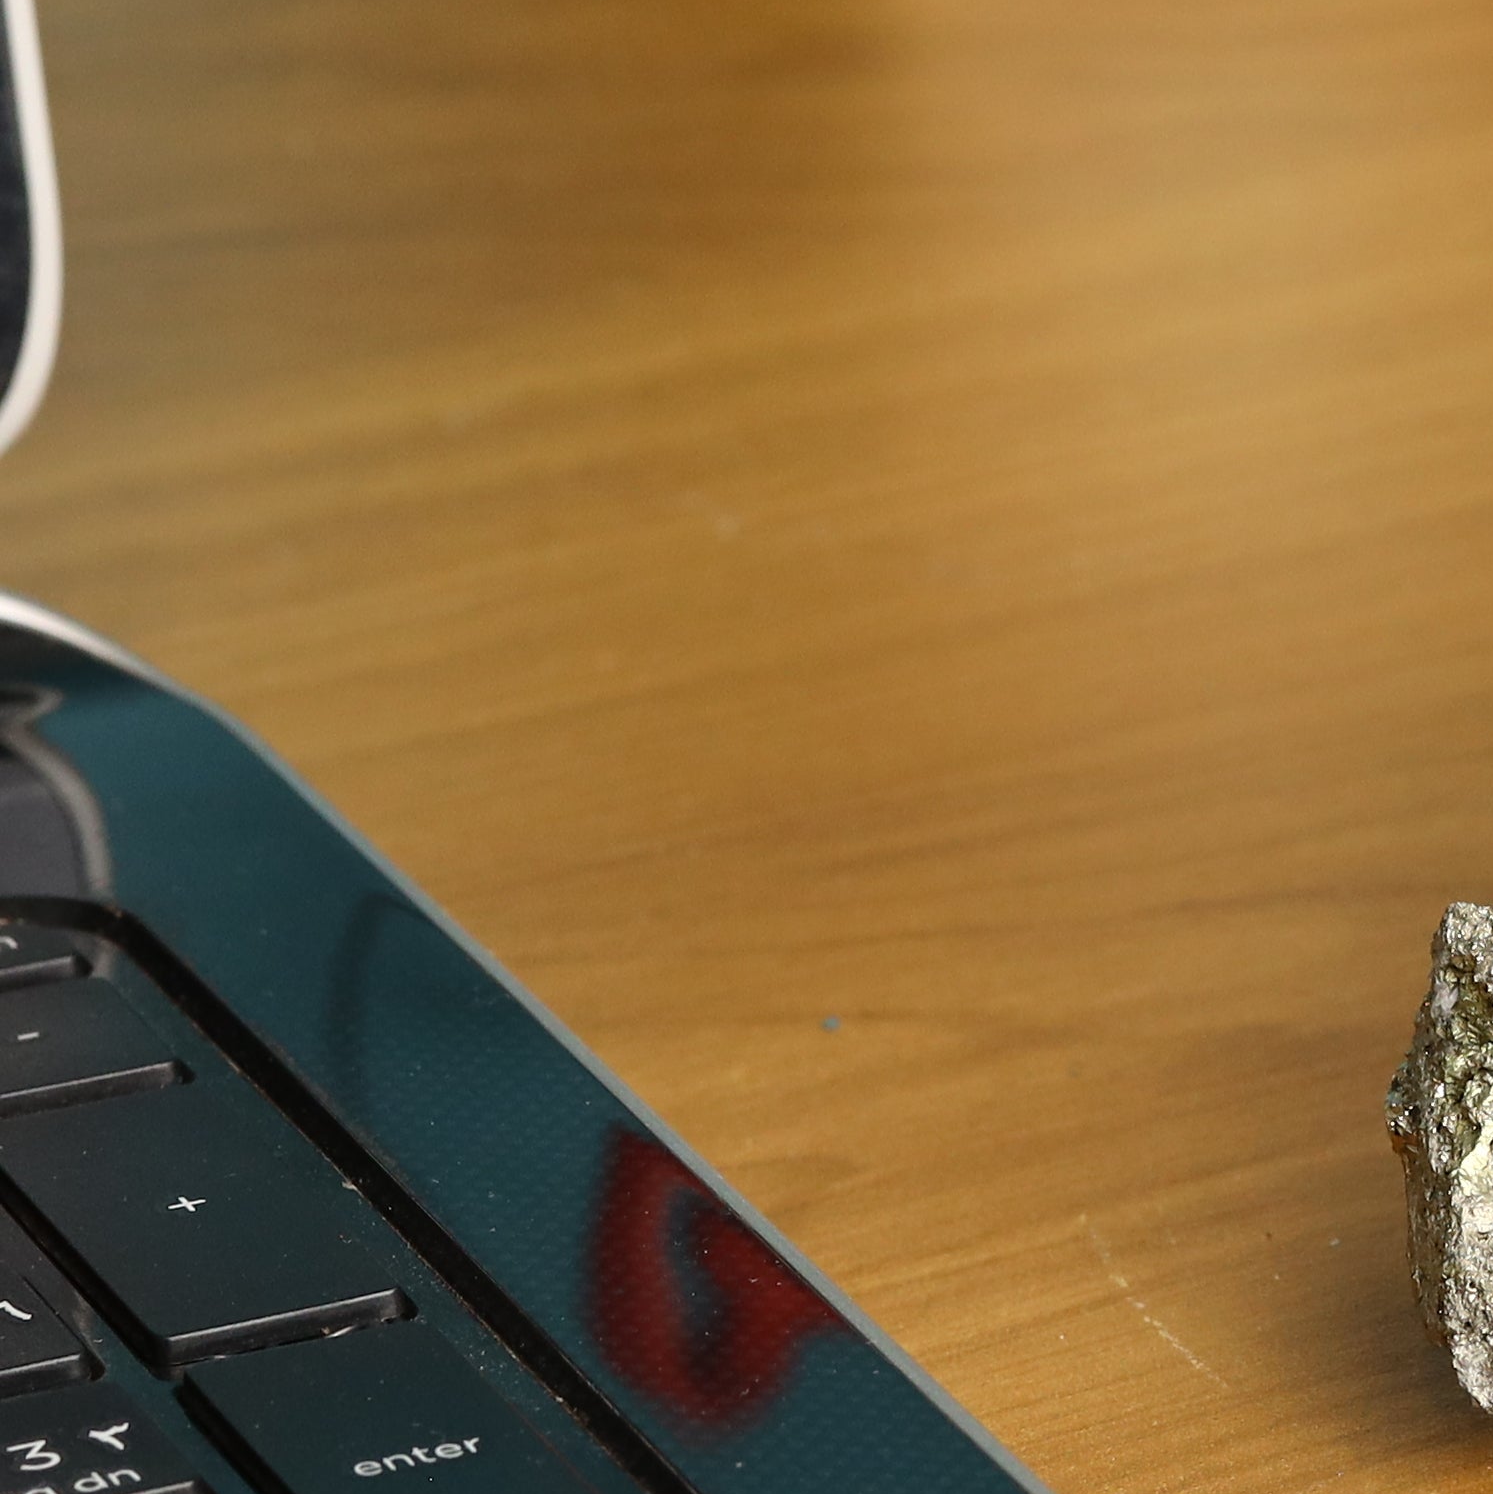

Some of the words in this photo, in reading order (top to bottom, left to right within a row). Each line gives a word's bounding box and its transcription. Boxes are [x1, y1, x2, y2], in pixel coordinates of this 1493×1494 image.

[6, 1439, 61, 1471] 3
[353, 1436, 480, 1477] enter
[73, 1468, 142, 1493] dn
